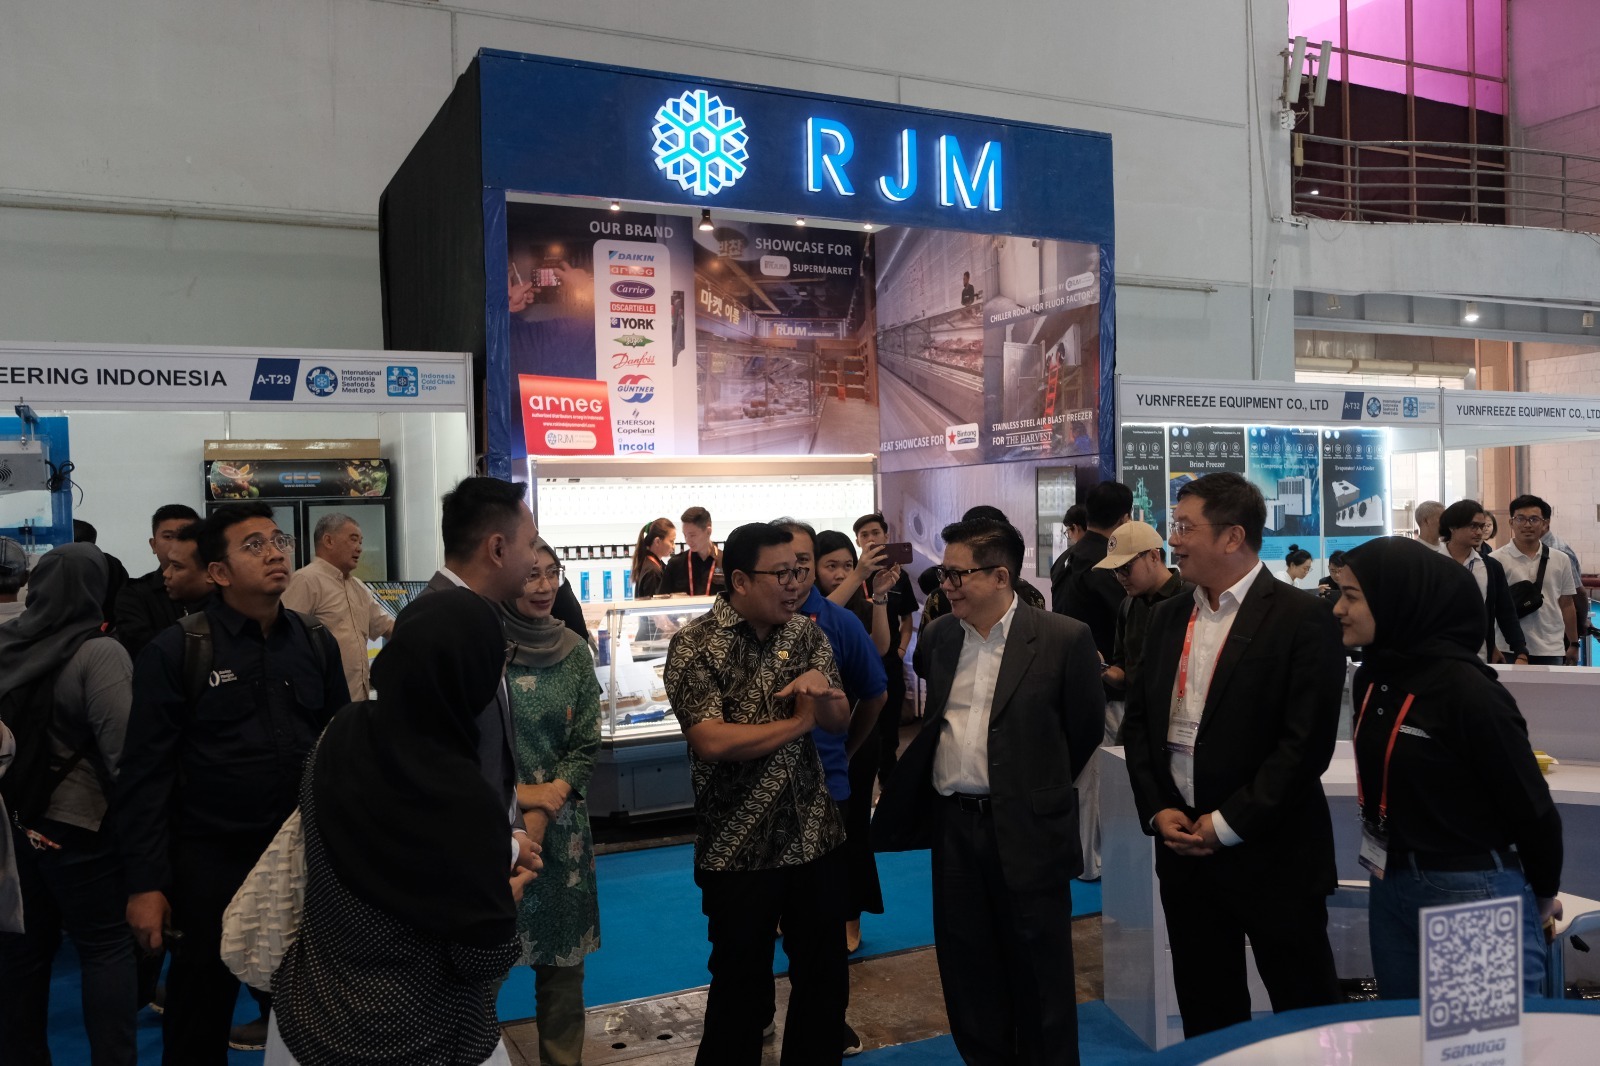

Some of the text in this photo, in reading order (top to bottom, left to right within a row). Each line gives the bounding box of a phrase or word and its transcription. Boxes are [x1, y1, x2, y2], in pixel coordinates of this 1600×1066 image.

[806, 117, 1003, 211] RJM
[589, 221, 674, 239] OUR BRAND
[755, 238, 852, 256] SHOWCASE FOR
[618, 253, 655, 262] DAIKIN
[793, 263, 853, 276] SUPERMARKET
[616, 284, 650, 294] Carrier
[611, 303, 655, 313] OSCARTIELLE
[990, 311, 1011, 323] CHILLER
[1013, 307, 1031, 317] ROOM
[1032, 303, 1044, 312] FOR
[1045, 297, 1065, 309] FLUOR
[621, 318, 654, 330] YORK
[612, 351, 656, 369] Danfoss
[97, 368, 228, 387] INDONESIA
[256, 374, 292, 385] A-T29
[617, 385, 655, 393] GÜNTNER
[1136, 394, 1329, 412] YURNFREEZE EQUIPMENT CO., LTD
[1456, 404, 1600, 420] YURNFREEZE EQUIPMENT CO., LTD
[992, 411, 1093, 432] STAINLESS STEEL AIR BLAST FREEZER
[895, 437, 930, 450] SHOWCASE
[931, 434, 945, 446] FOR
[992, 431, 1053, 446] FOR THE HARVEST
[619, 442, 655, 451] incold
[1189, 460, 1204, 468] Brine
[279, 471, 321, 484] GES
[1399, 724, 1431, 739] sanw
